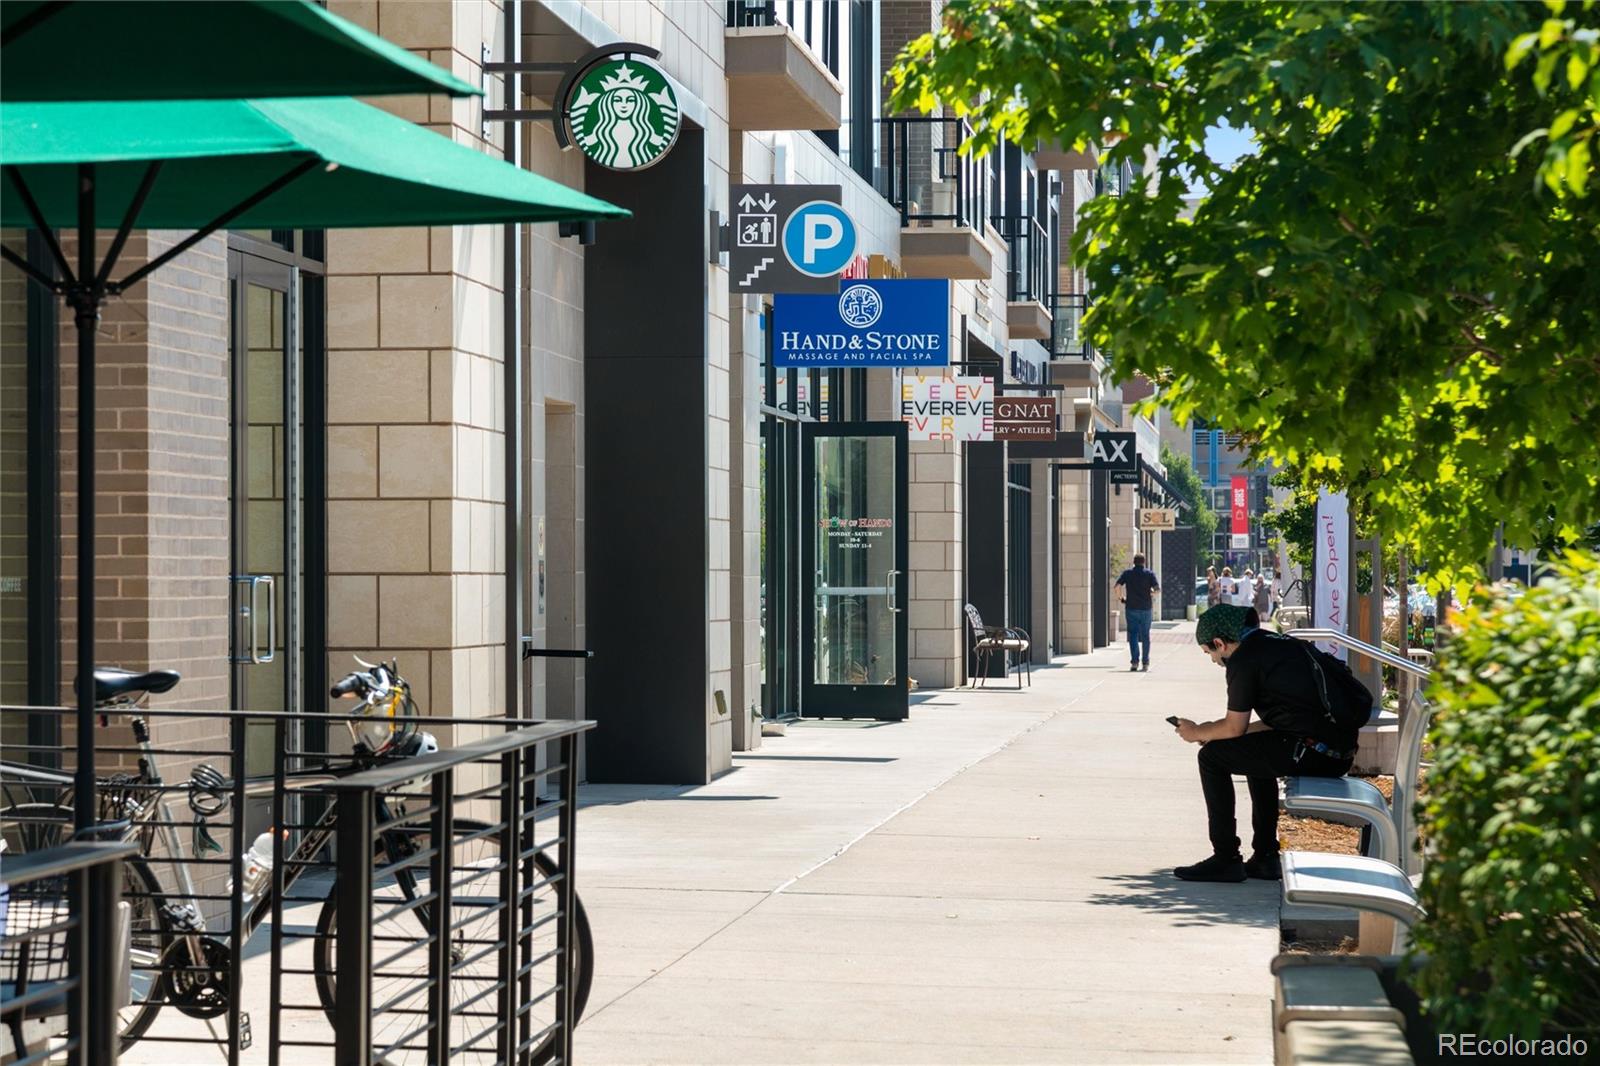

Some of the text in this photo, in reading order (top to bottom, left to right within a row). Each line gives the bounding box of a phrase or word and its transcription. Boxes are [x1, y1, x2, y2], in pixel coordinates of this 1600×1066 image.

[803, 213, 844, 264] P
[788, 352, 932, 361] MASSAGE AND FACIAL SPA
[902, 401, 994, 416] EVEREVE
[998, 403, 1052, 418] GNAT
[1017, 426, 1051, 434] ATELIER
[1322, 515, 1339, 583] Open!
[1329, 588, 1341, 627] Are
